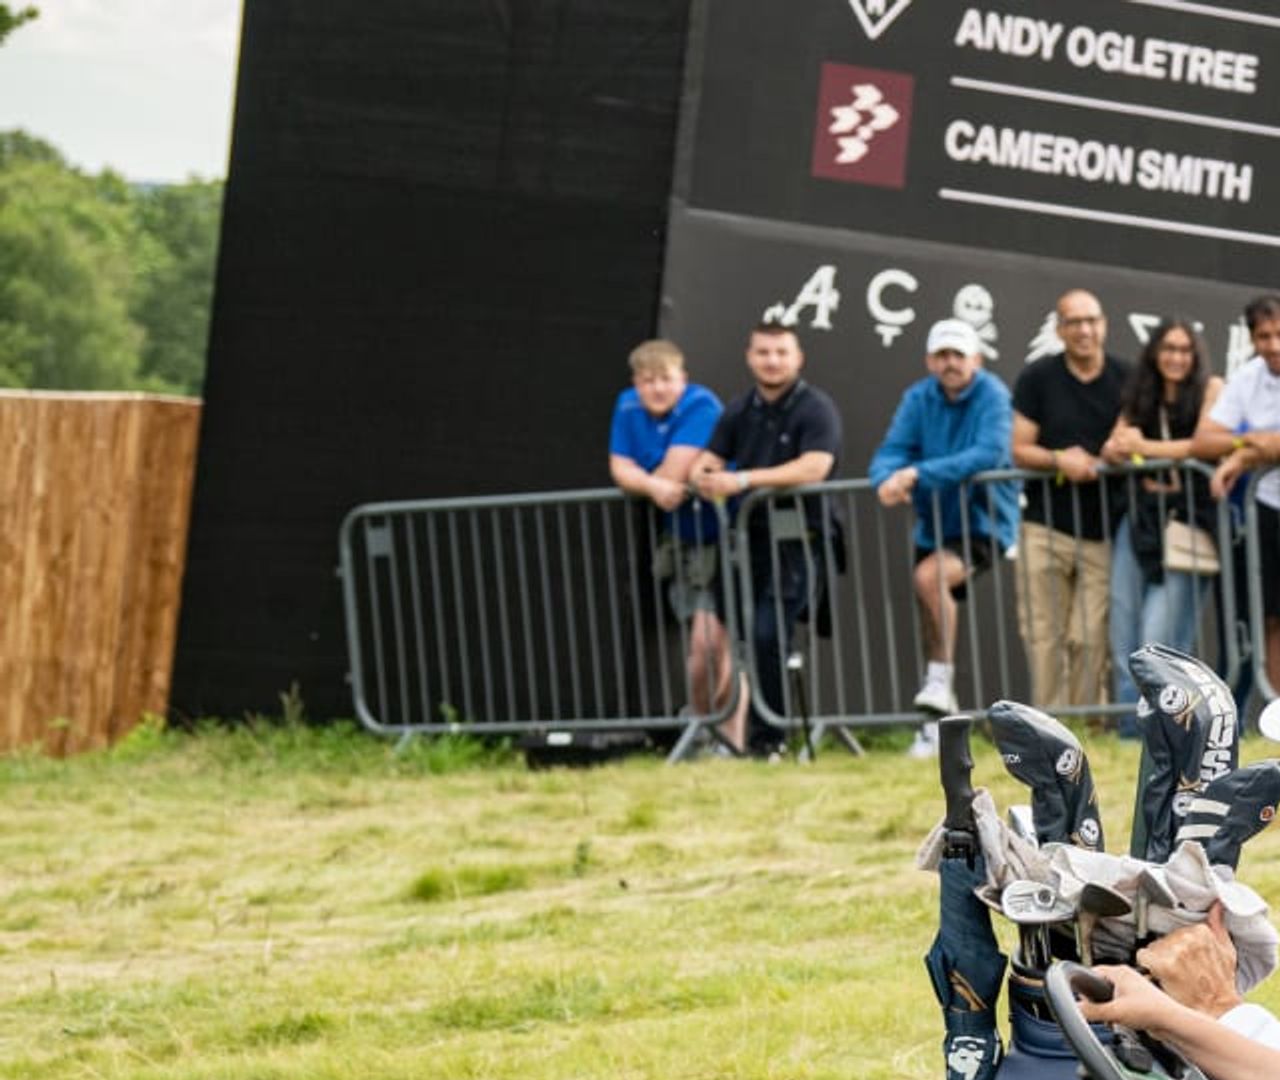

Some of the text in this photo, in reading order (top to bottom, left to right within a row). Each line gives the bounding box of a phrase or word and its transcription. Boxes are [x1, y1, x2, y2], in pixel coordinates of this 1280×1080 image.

[955, 9, 1062, 61] ANDY
[1067, 28, 1259, 94] OGLETREE
[945, 120, 1135, 187] CAMERON
[1137, 152, 1253, 203] SMITH
